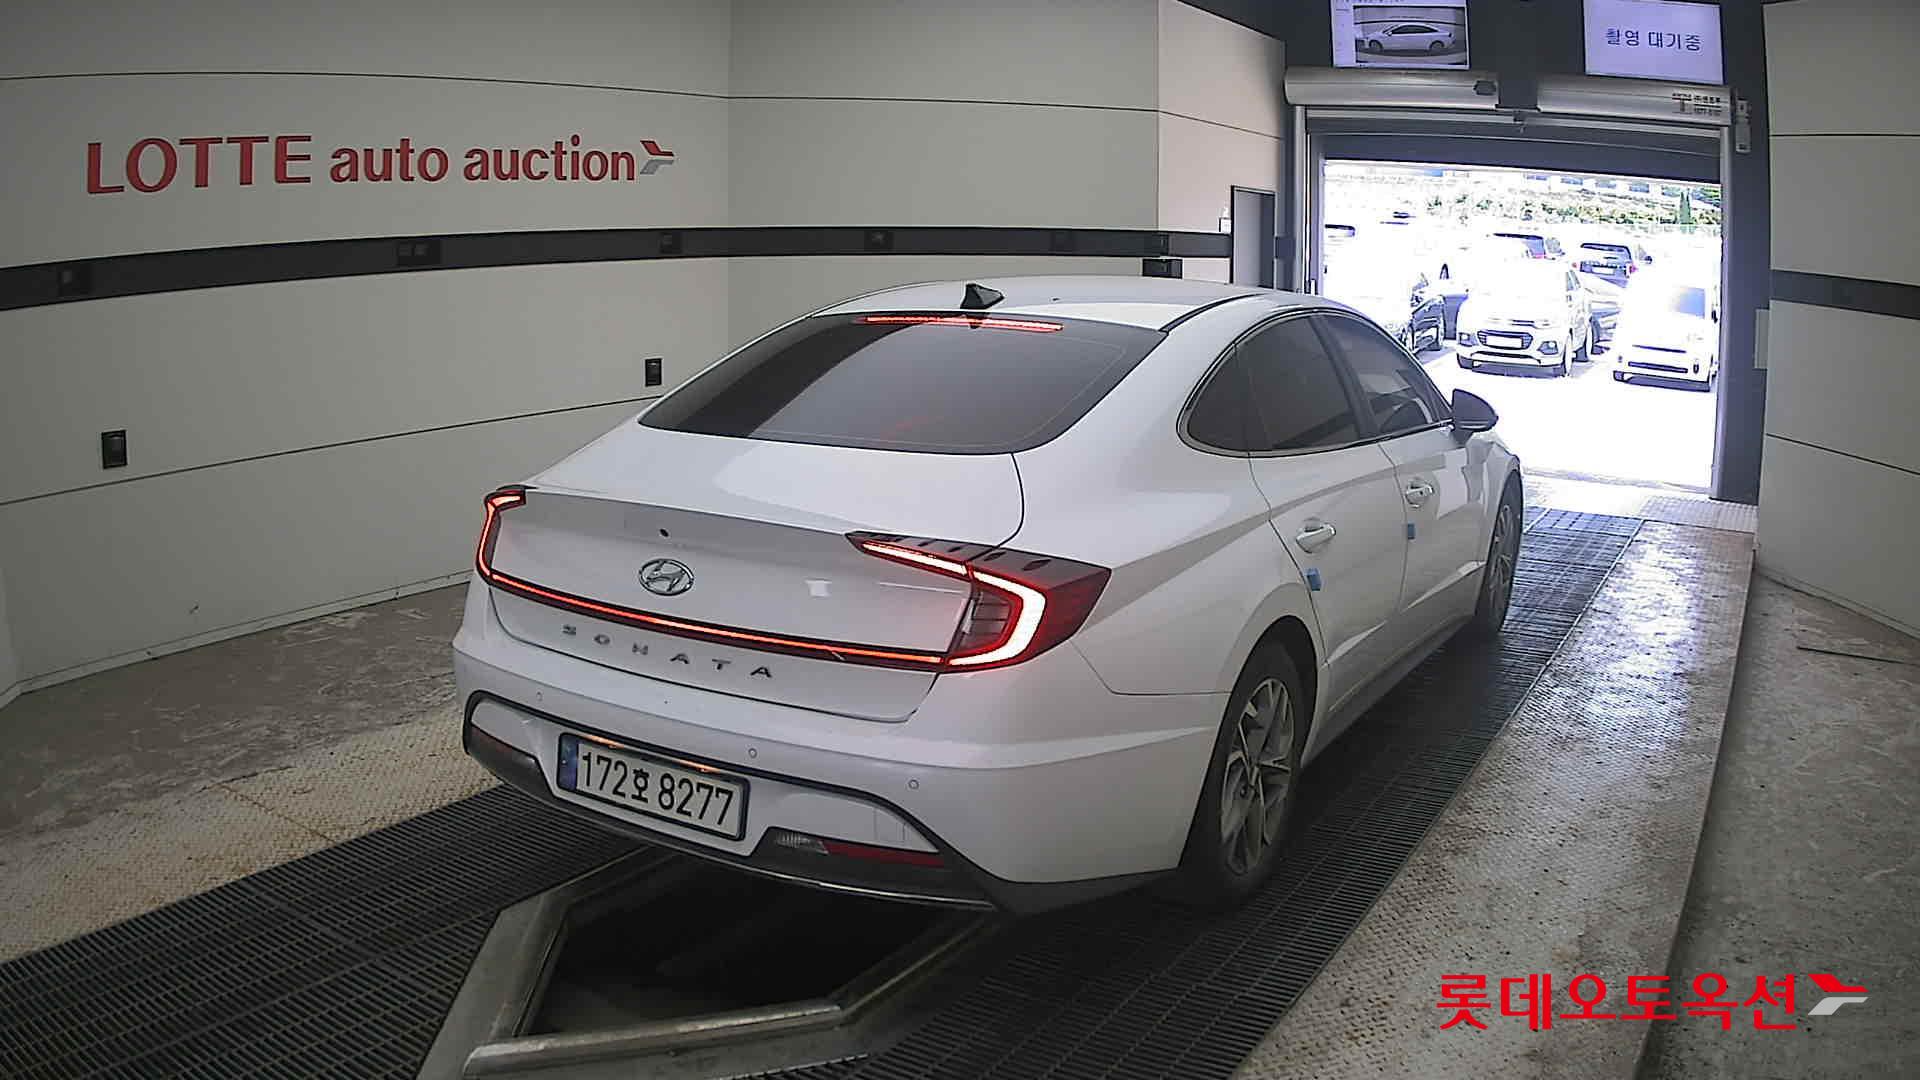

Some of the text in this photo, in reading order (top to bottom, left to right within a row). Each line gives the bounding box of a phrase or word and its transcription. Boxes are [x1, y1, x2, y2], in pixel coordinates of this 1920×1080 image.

[1648, 31, 1701, 51] 대기중
[87, 134, 636, 195] LOTTE auto auction
[562, 624, 773, 678] SONATA
[657, 772, 734, 826] 8277
